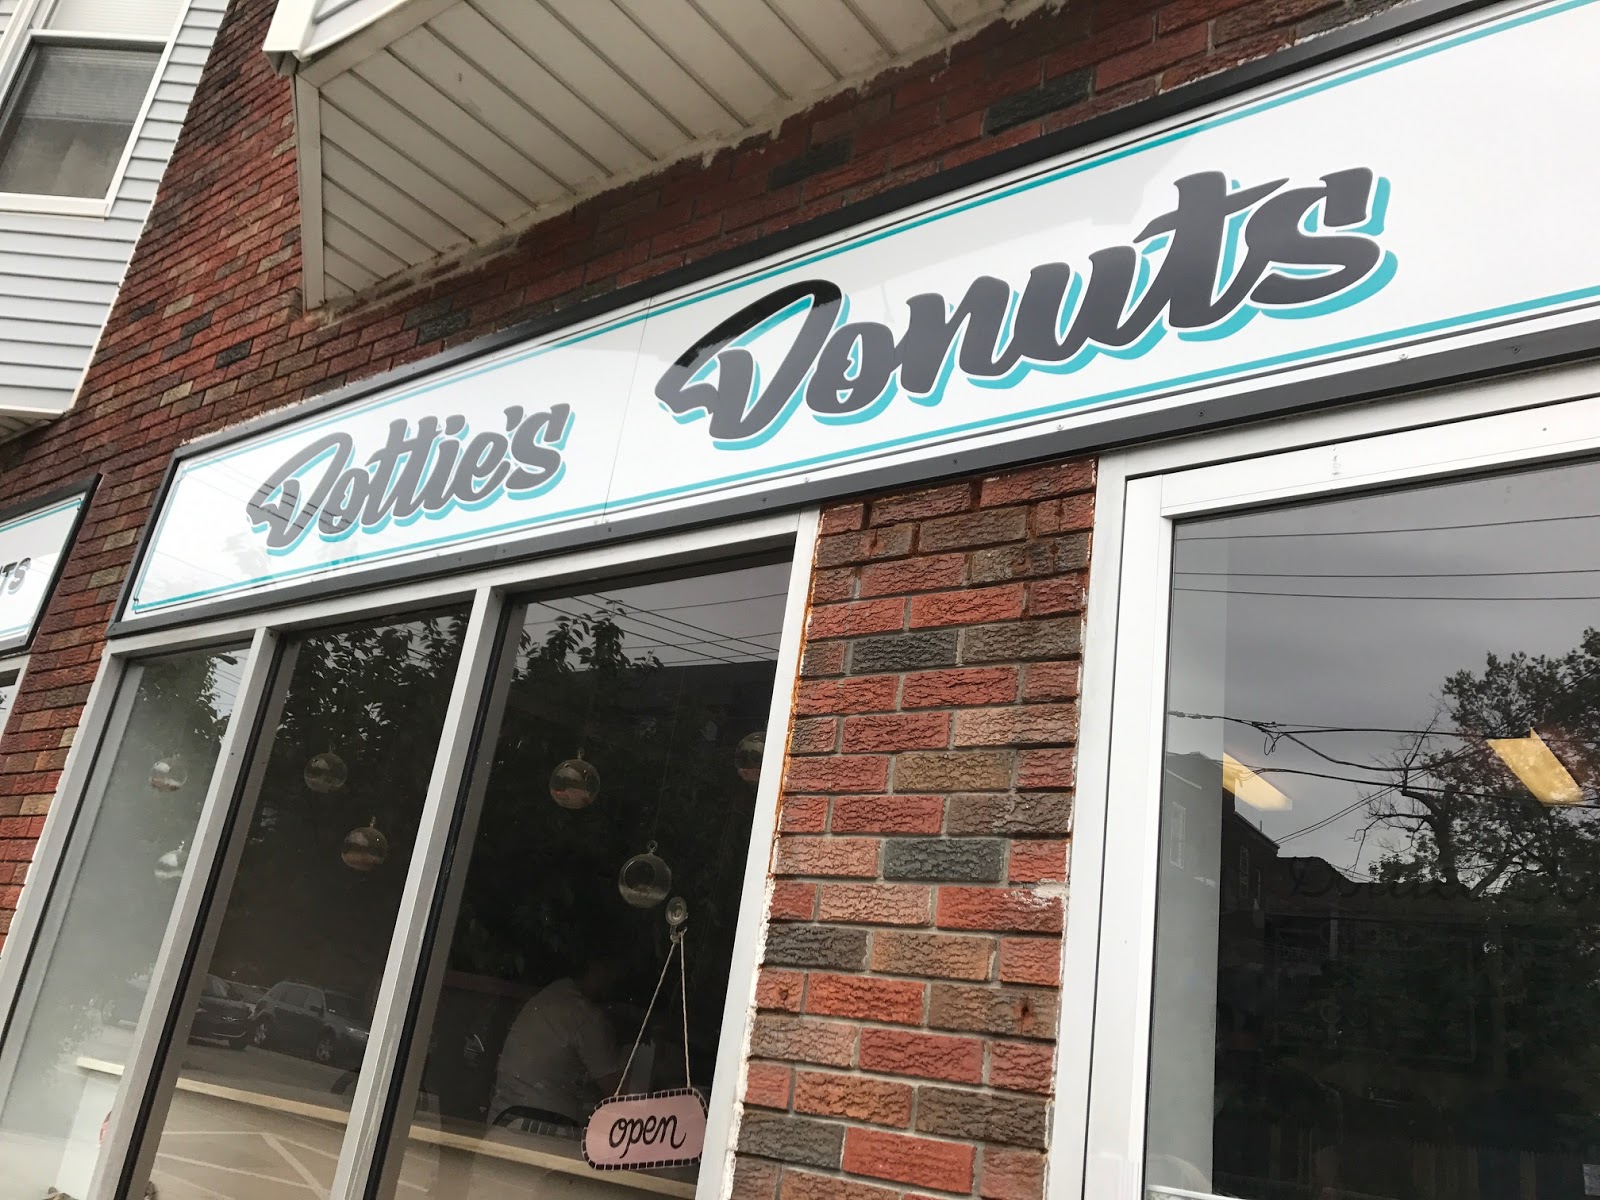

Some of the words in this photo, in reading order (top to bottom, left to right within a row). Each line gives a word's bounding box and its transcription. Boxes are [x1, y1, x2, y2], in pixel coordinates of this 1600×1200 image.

[246, 403, 574, 554] Dottie's
[654, 167, 1396, 449] Donuts
[0, 557, 31, 592] TS
[608, 1115, 686, 1159] open
